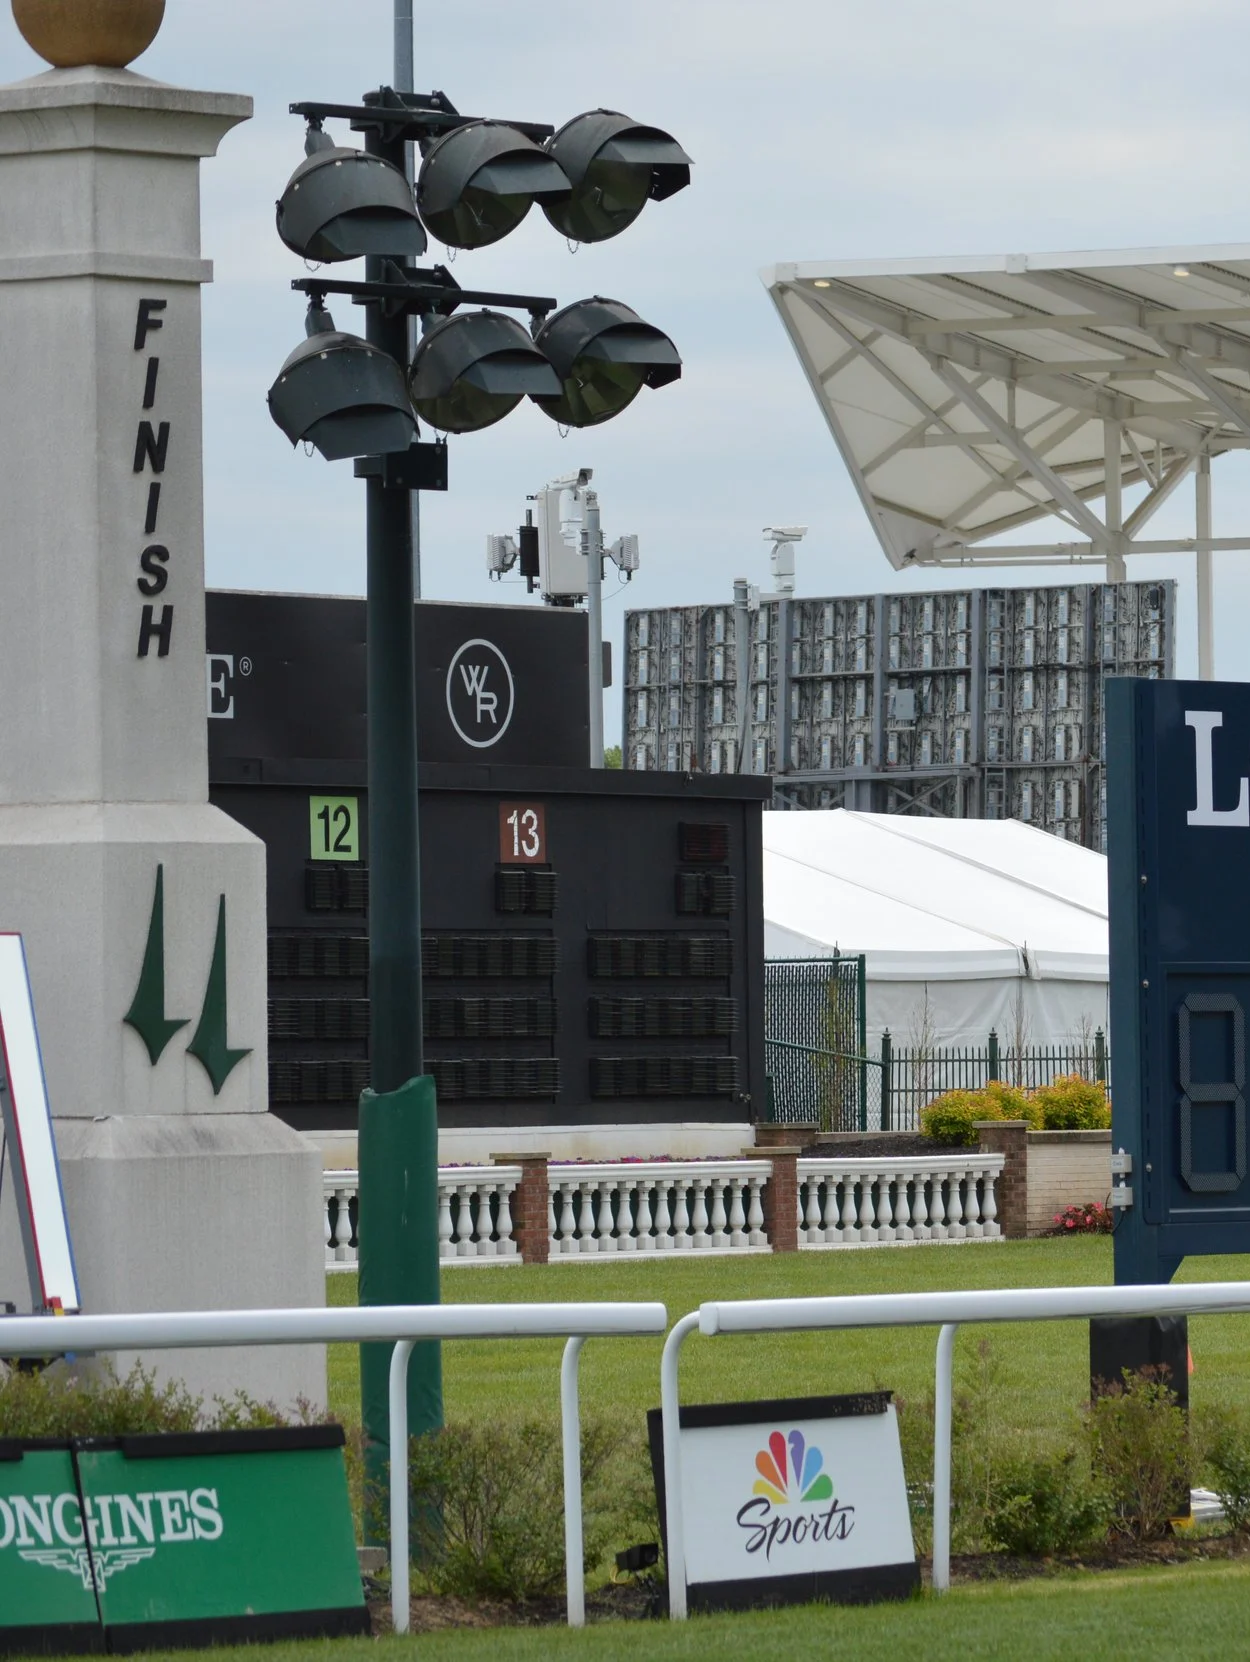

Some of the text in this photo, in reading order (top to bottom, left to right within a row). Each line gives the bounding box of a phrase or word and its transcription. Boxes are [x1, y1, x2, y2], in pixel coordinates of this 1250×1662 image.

[133, 298, 174, 657] FINISH
[317, 804, 352, 852] 12
[506, 809, 540, 857] 13
[736, 1497, 855, 1563] Sports
